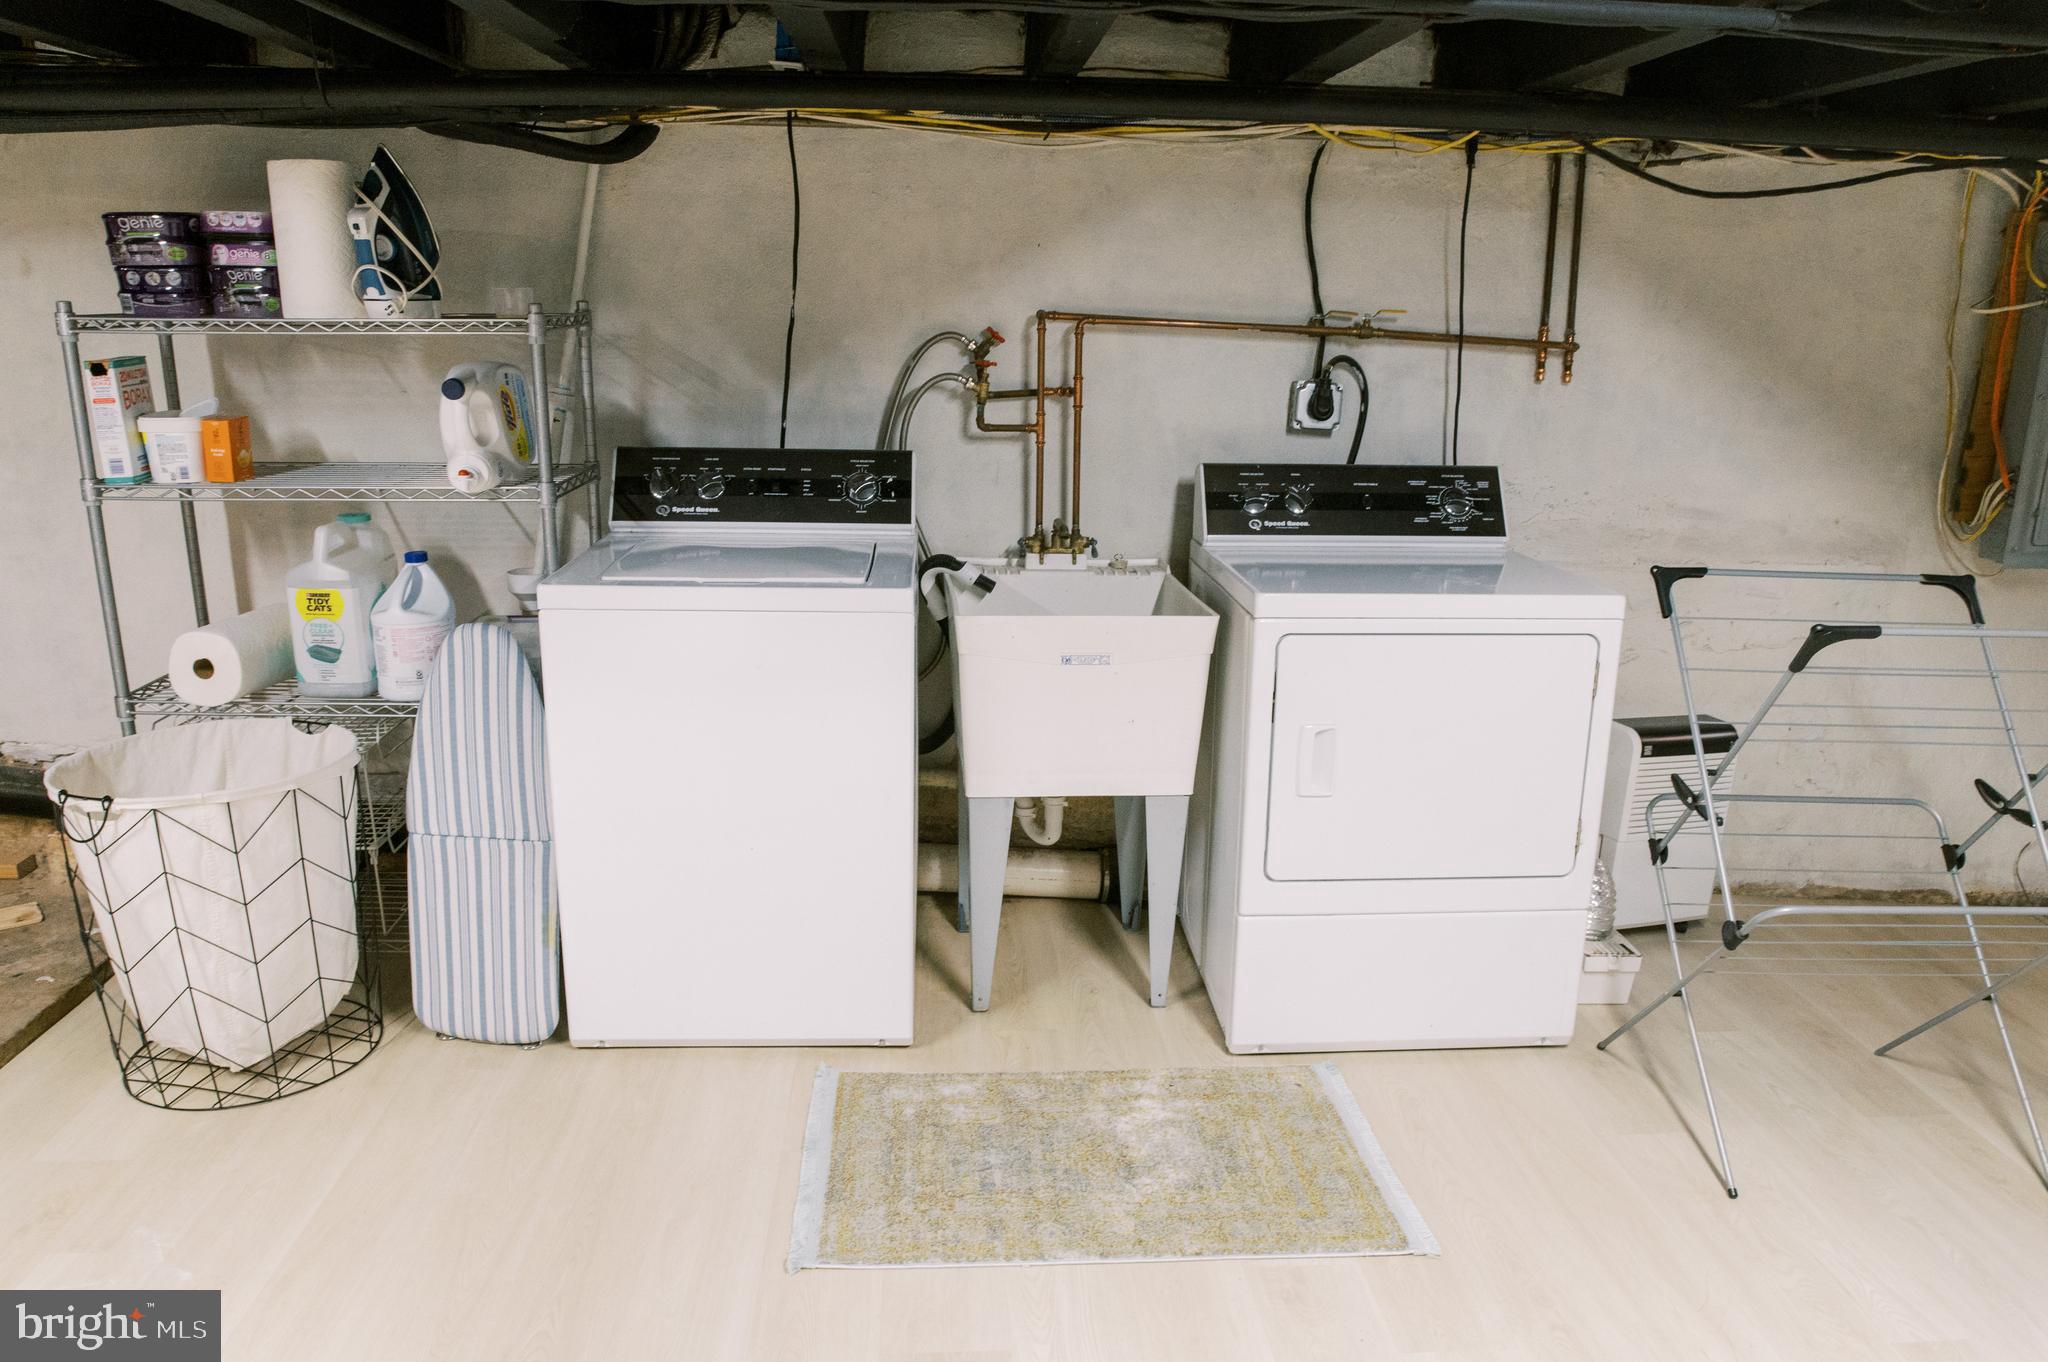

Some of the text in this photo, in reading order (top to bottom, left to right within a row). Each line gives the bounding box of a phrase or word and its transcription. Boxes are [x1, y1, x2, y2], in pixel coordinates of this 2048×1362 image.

[117, 217, 165, 232] genie
[229, 249, 260, 260] genie
[227, 270, 263, 283] genie
[306, 597, 330, 605] TIDY
[306, 604, 332, 612] CATS
